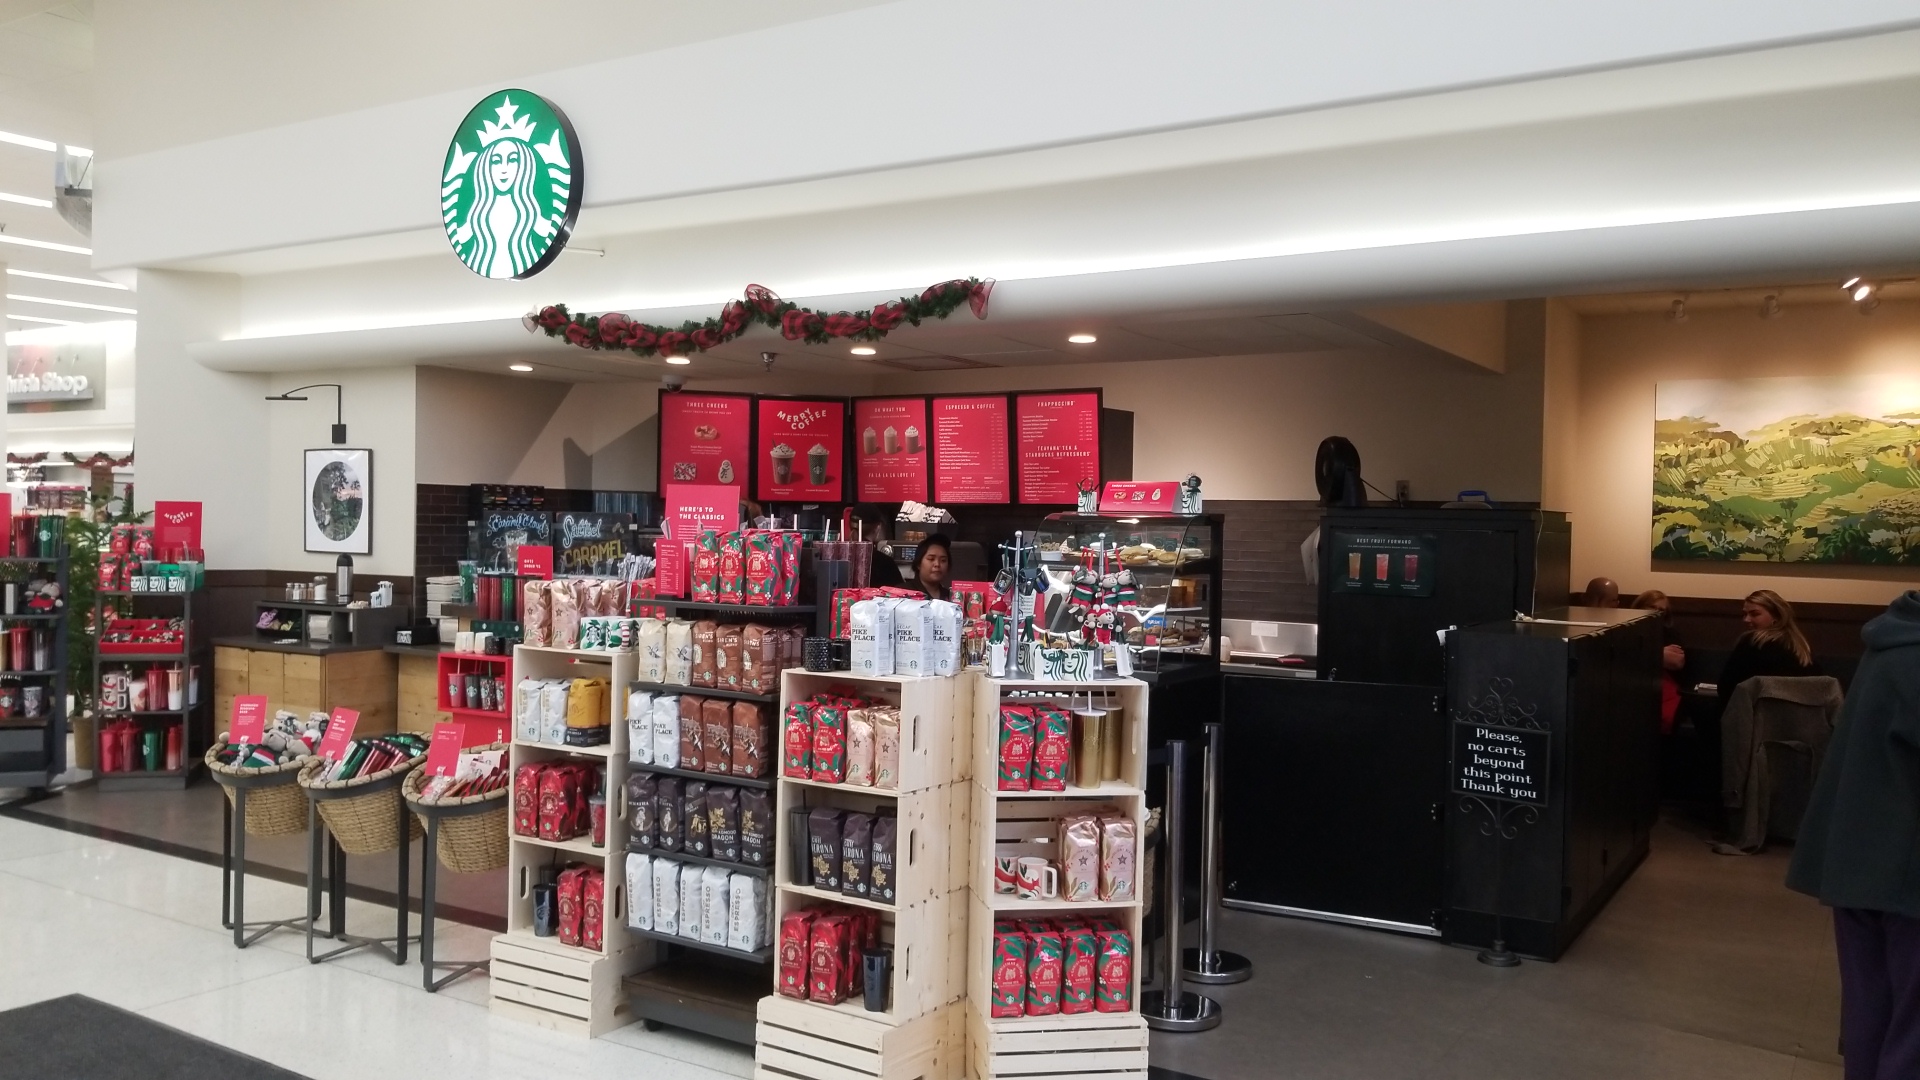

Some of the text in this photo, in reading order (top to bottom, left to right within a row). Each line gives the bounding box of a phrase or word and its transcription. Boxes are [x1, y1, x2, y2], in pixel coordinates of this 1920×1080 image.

[42, 371, 88, 396] Shop
[777, 407, 812, 422] MERRY
[791, 409, 827, 430] COFFEE
[563, 515, 602, 548] Salted
[563, 540, 626, 568] CARAMEL
[1476, 727, 1522, 743] Please,
[1467, 743, 1526, 757] no carts
[1474, 754, 1525, 770] beyond
[1463, 766, 1532, 784] this point
[1460, 778, 1537, 799] Thank you
[742, 836, 761, 844] DRAGON
[811, 844, 834, 854] VERONA
[843, 846, 864, 859] VERONA
[872, 852, 892, 864] VERONA
